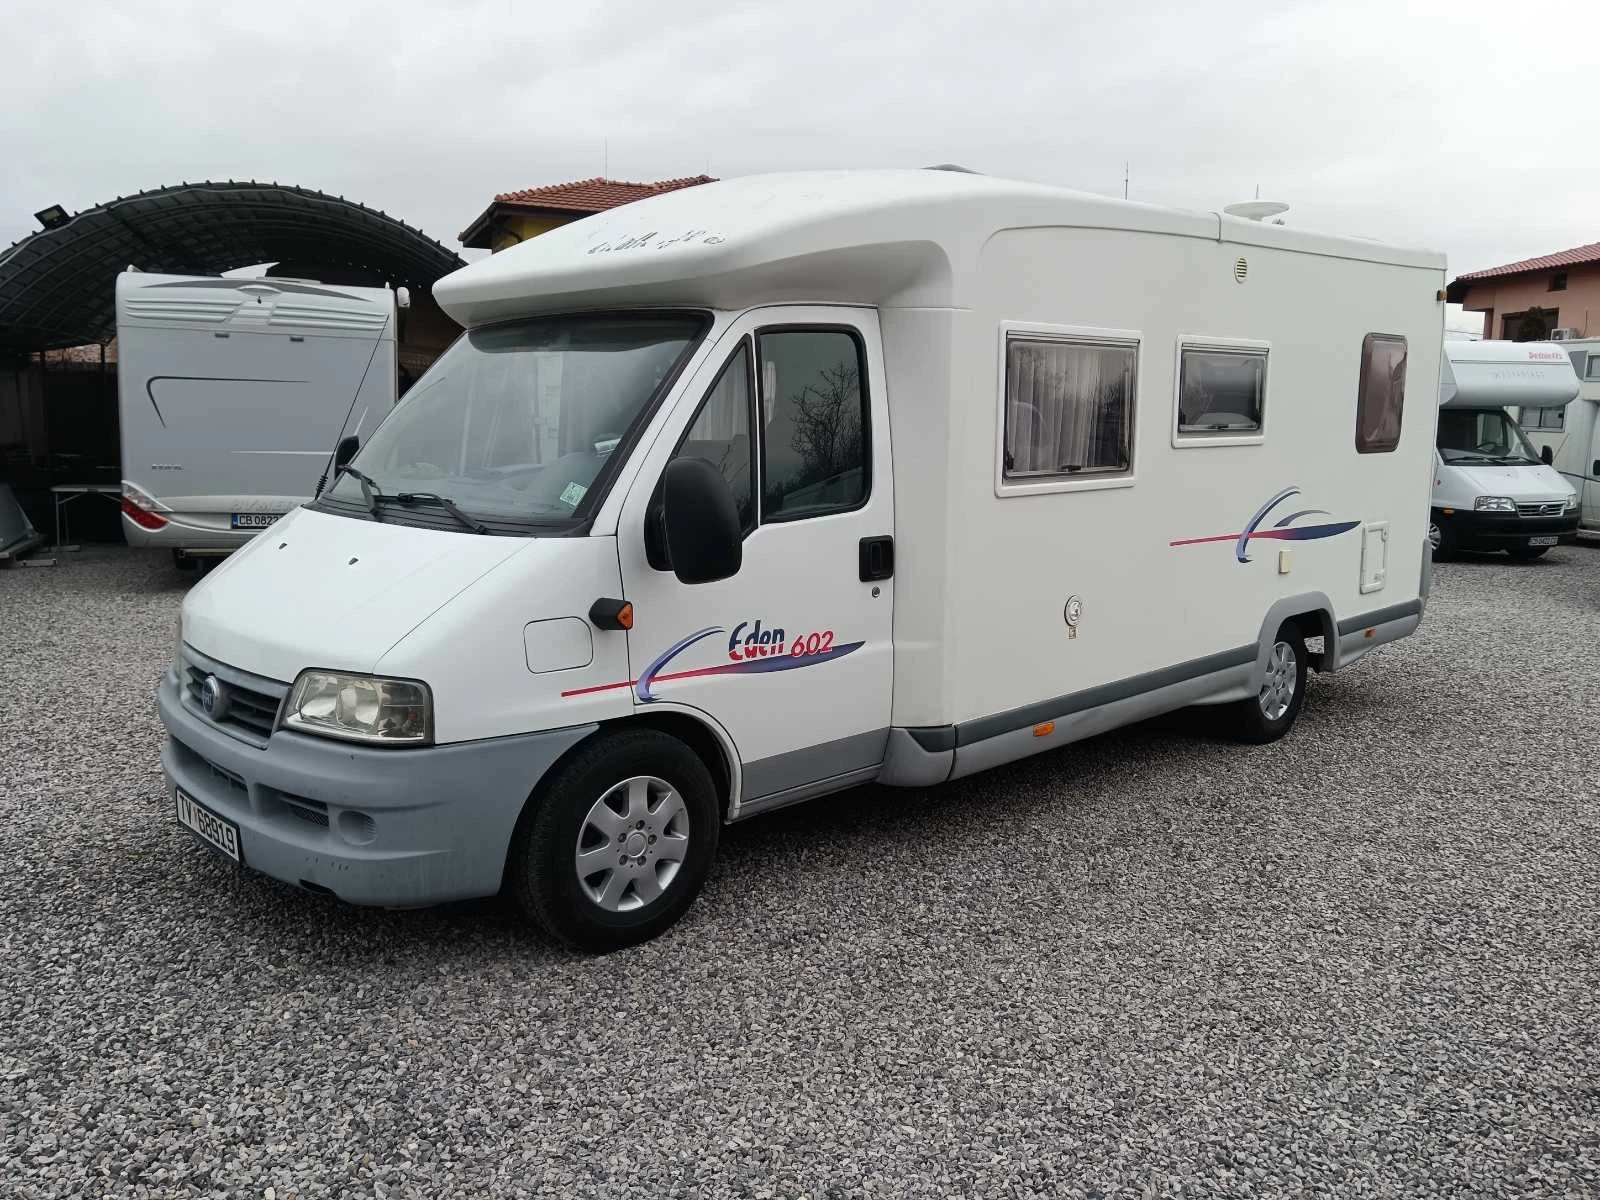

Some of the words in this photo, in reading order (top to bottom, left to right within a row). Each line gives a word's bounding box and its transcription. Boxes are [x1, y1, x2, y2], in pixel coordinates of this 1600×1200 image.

[728, 619, 785, 661] Eden
[790, 630, 834, 658] 602
[179, 794, 192, 825] TV
[197, 807, 236, 855] 68919
